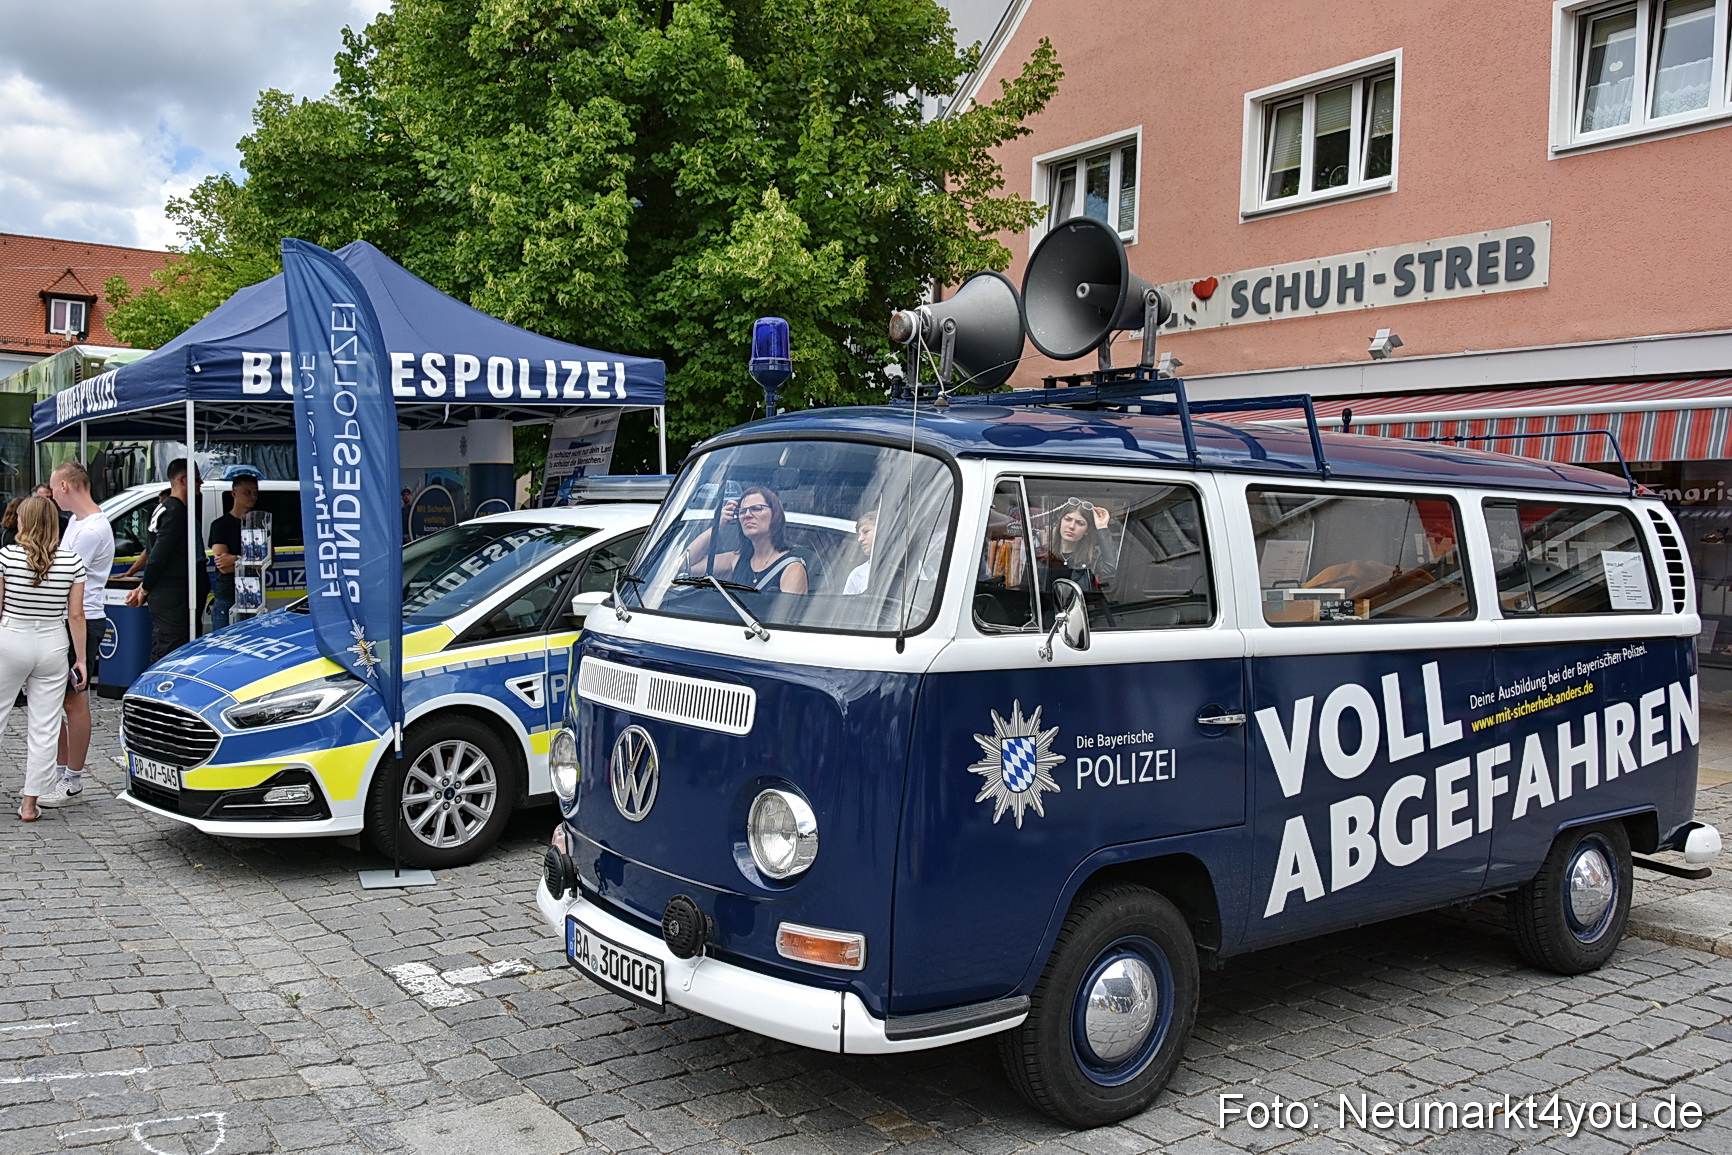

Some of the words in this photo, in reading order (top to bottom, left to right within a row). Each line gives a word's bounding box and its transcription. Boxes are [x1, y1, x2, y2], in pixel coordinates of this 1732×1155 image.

[1231, 235, 1535, 318] SCHUH-STREB
[1650, 481, 1732, 501] maris
[265, 569, 306, 587] OLIZ
[1470, 692, 1495, 709] Deine
[1498, 677, 1547, 700] Ausbildung
[1548, 669, 1561, 685] bei
[1562, 665, 1576, 680] der
[1577, 652, 1622, 677] Bayerischen
[1471, 680, 1594, 732] www.mit-sicherheit-anders.de
[1076, 735, 1094, 749] Die
[1097, 730, 1154, 750] Bayerische
[1254, 660, 1464, 798] VOLL
[1076, 749, 1176, 790] POLIZEI
[1263, 674, 1699, 919] ABGEFAHREN
[575, 927, 590, 966] BA
[599, 943, 657, 998] 30000
